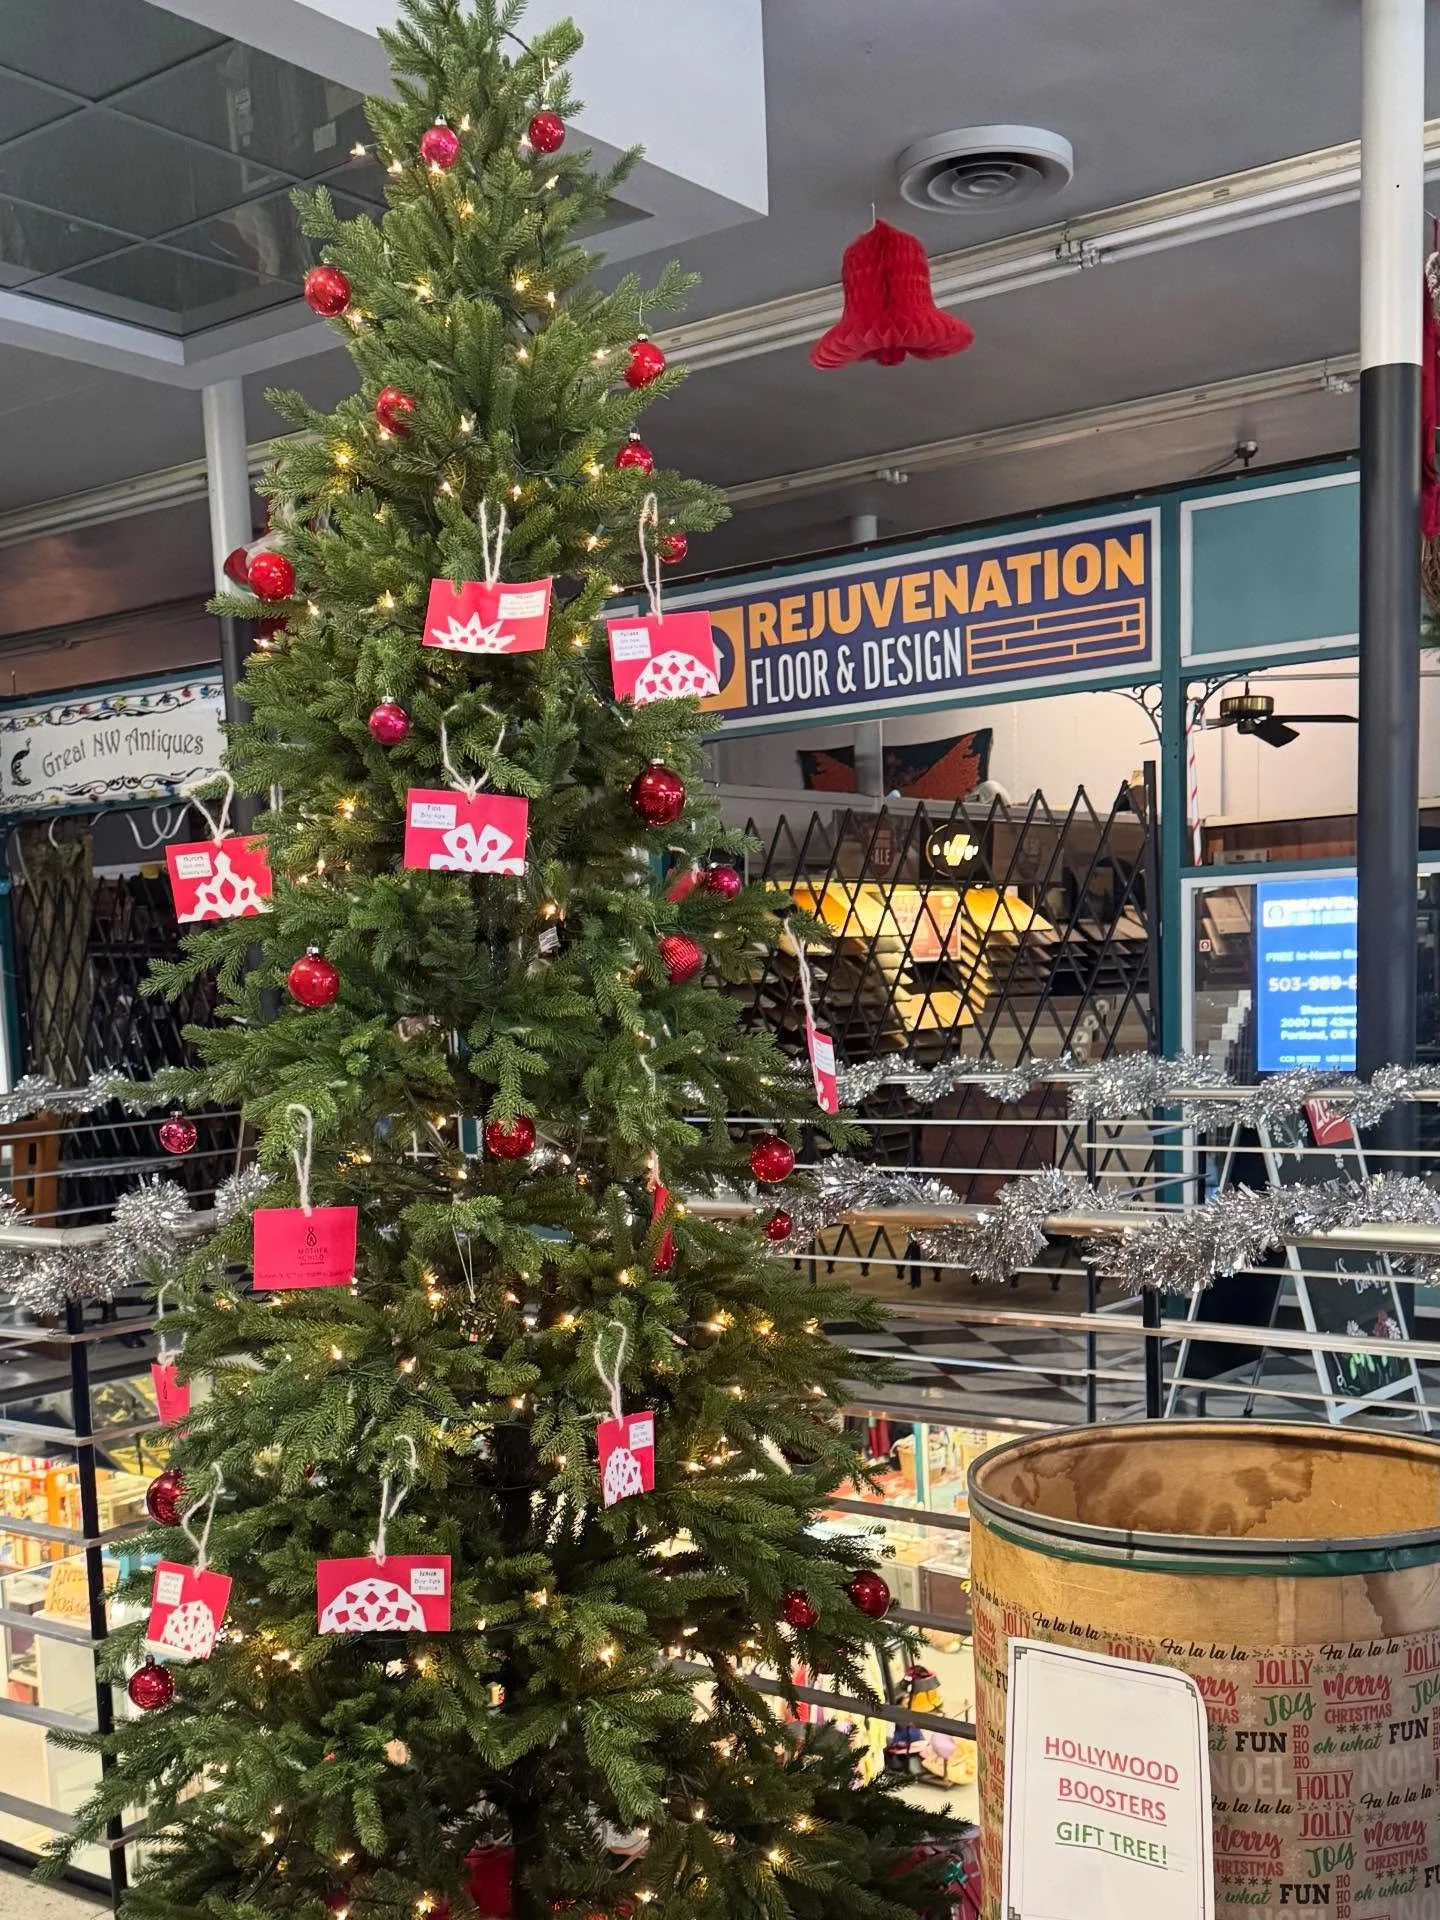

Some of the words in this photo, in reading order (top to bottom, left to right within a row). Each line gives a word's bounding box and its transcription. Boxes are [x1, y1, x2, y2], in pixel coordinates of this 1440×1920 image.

[749, 533, 1145, 649] REJUVENATION
[751, 648, 828, 706] FLOOR
[837, 644, 857, 693] &
[862, 627, 962, 690] DESIGN
[42, 739, 87, 778] Great
[93, 730, 121, 758] NW
[125, 727, 204, 760] Antiques
[1053, 1616, 1068, 1632] la
[1069, 1620, 1085, 1637] la
[1085, 1624, 1101, 1641] la
[1189, 1641, 1206, 1658] la
[1209, 1643, 1228, 1659] la
[1231, 1644, 1249, 1660] la
[1348, 1642, 1366, 1659] la
[1367, 1641, 1385, 1657] la
[1386, 1638, 1401, 1655] la
[1404, 1640, 1440, 1674] JOLL
[1255, 1659, 1313, 1685] JOLLY
[1325, 1703, 1392, 1724] CHRISTMAS
[1235, 1731, 1287, 1753] FUN
[1292, 1725, 1309, 1738] HO
[1314, 1736, 1337, 1754] oh
[1340, 1733, 1384, 1752] what
[1389, 1717, 1429, 1745] FUN
[1292, 1740, 1309, 1754] HO
[1045, 1736, 1180, 1785] HOLLYWOOD
[1293, 1756, 1310, 1769] HO
[1296, 1773, 1353, 1801] HOLLY
[1387, 1791, 1400, 1807] la
[1401, 1787, 1417, 1803] la
[1421, 1784, 1433, 1799] la
[1059, 1777, 1167, 1822] BOOSTERS
[1232, 1797, 1252, 1813] la
[1254, 1798, 1273, 1814] la
[1275, 1799, 1294, 1815] la
[1299, 1809, 1354, 1838] JOLLY
[1056, 1821, 1105, 1846] GIFT
[1109, 1831, 1168, 1866] TREE!
[1214, 1860, 1284, 1878] HRISTMAS
[1365, 1847, 1428, 1871] CHRISTMAS
[1336, 1874, 1350, 1889] HO
[1354, 1884, 1375, 1901] oh
[1379, 1875, 1420, 1896] what
[1225, 1887, 1272, 1905] what
[1279, 1883, 1331, 1905] FUN
[1336, 1890, 1350, 1904] HO
[1336, 1905, 1350, 1919] HO
